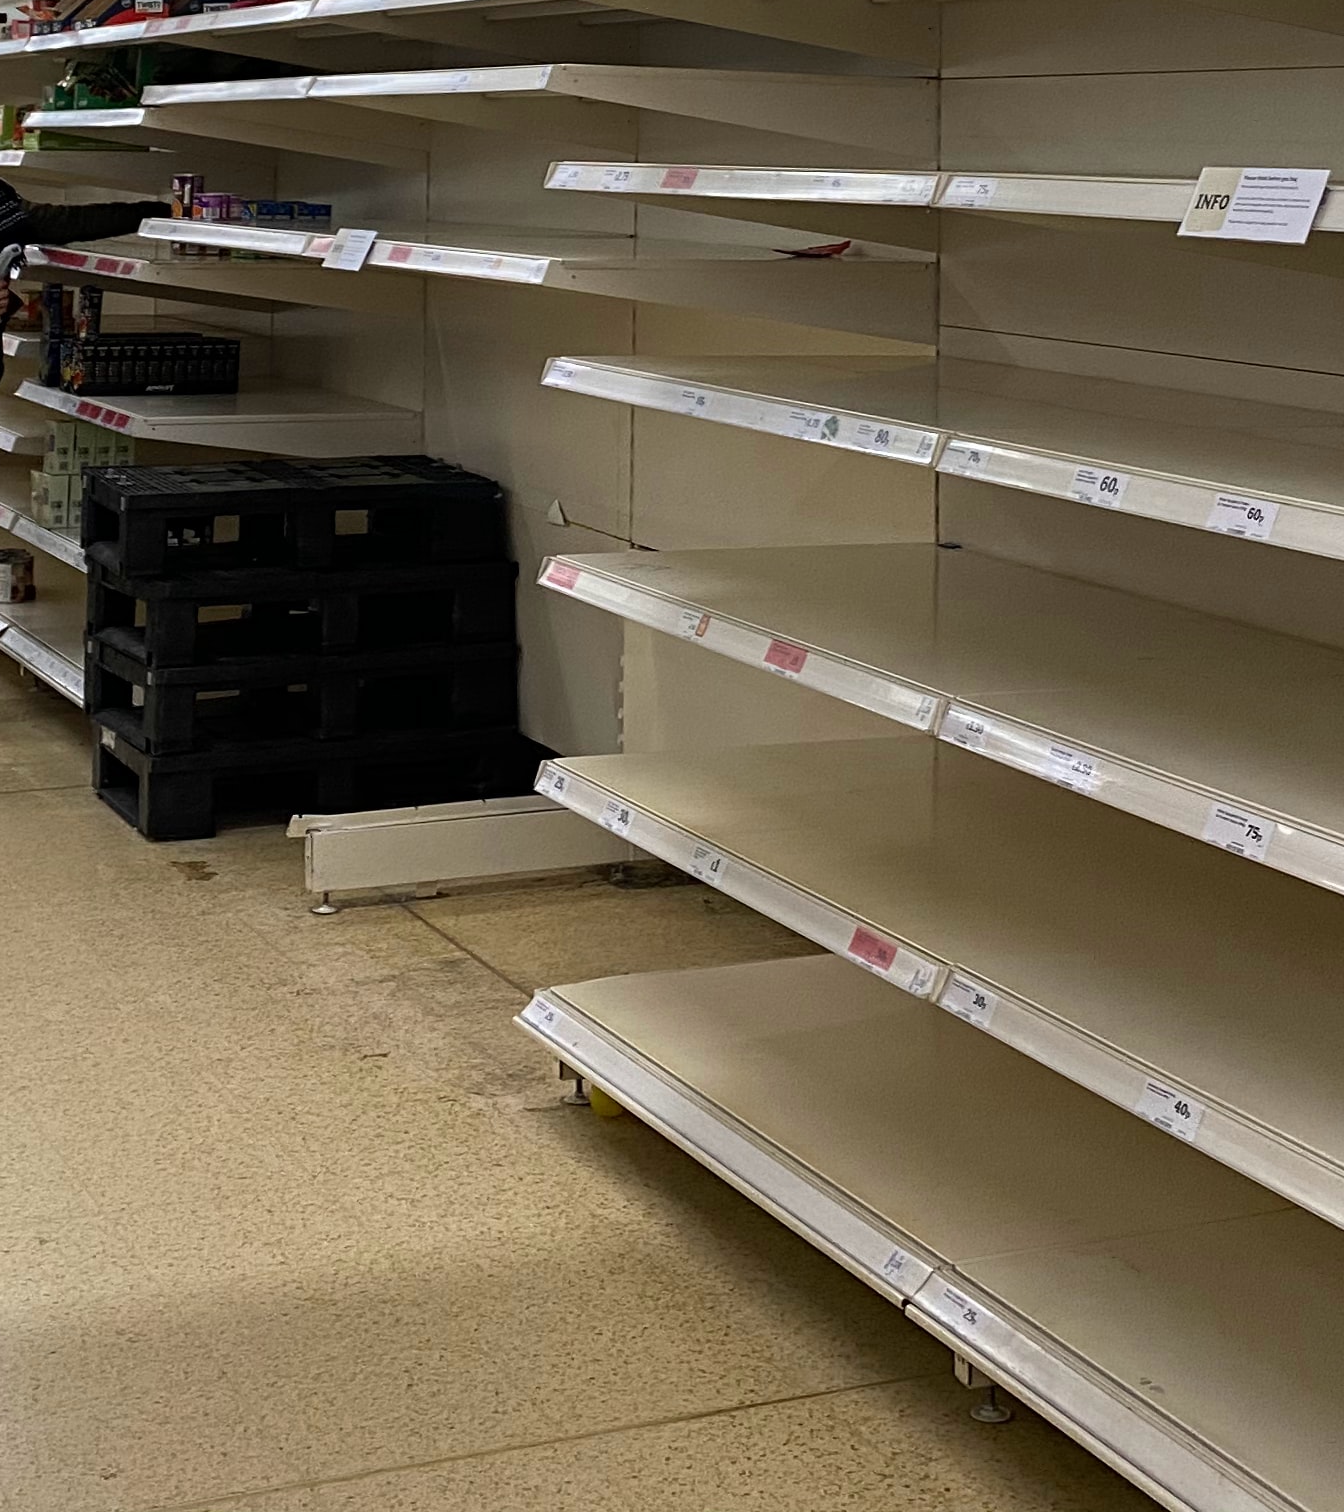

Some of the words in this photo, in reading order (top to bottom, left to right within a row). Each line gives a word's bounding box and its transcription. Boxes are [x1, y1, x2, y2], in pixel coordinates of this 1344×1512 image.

[1194, 193, 1230, 210] INFO
[1099, 476, 1119, 496] 60p
[1246, 507, 1265, 525] 60p
[1245, 824, 1263, 843] 75p
[1174, 1100, 1192, 1120] 40p
